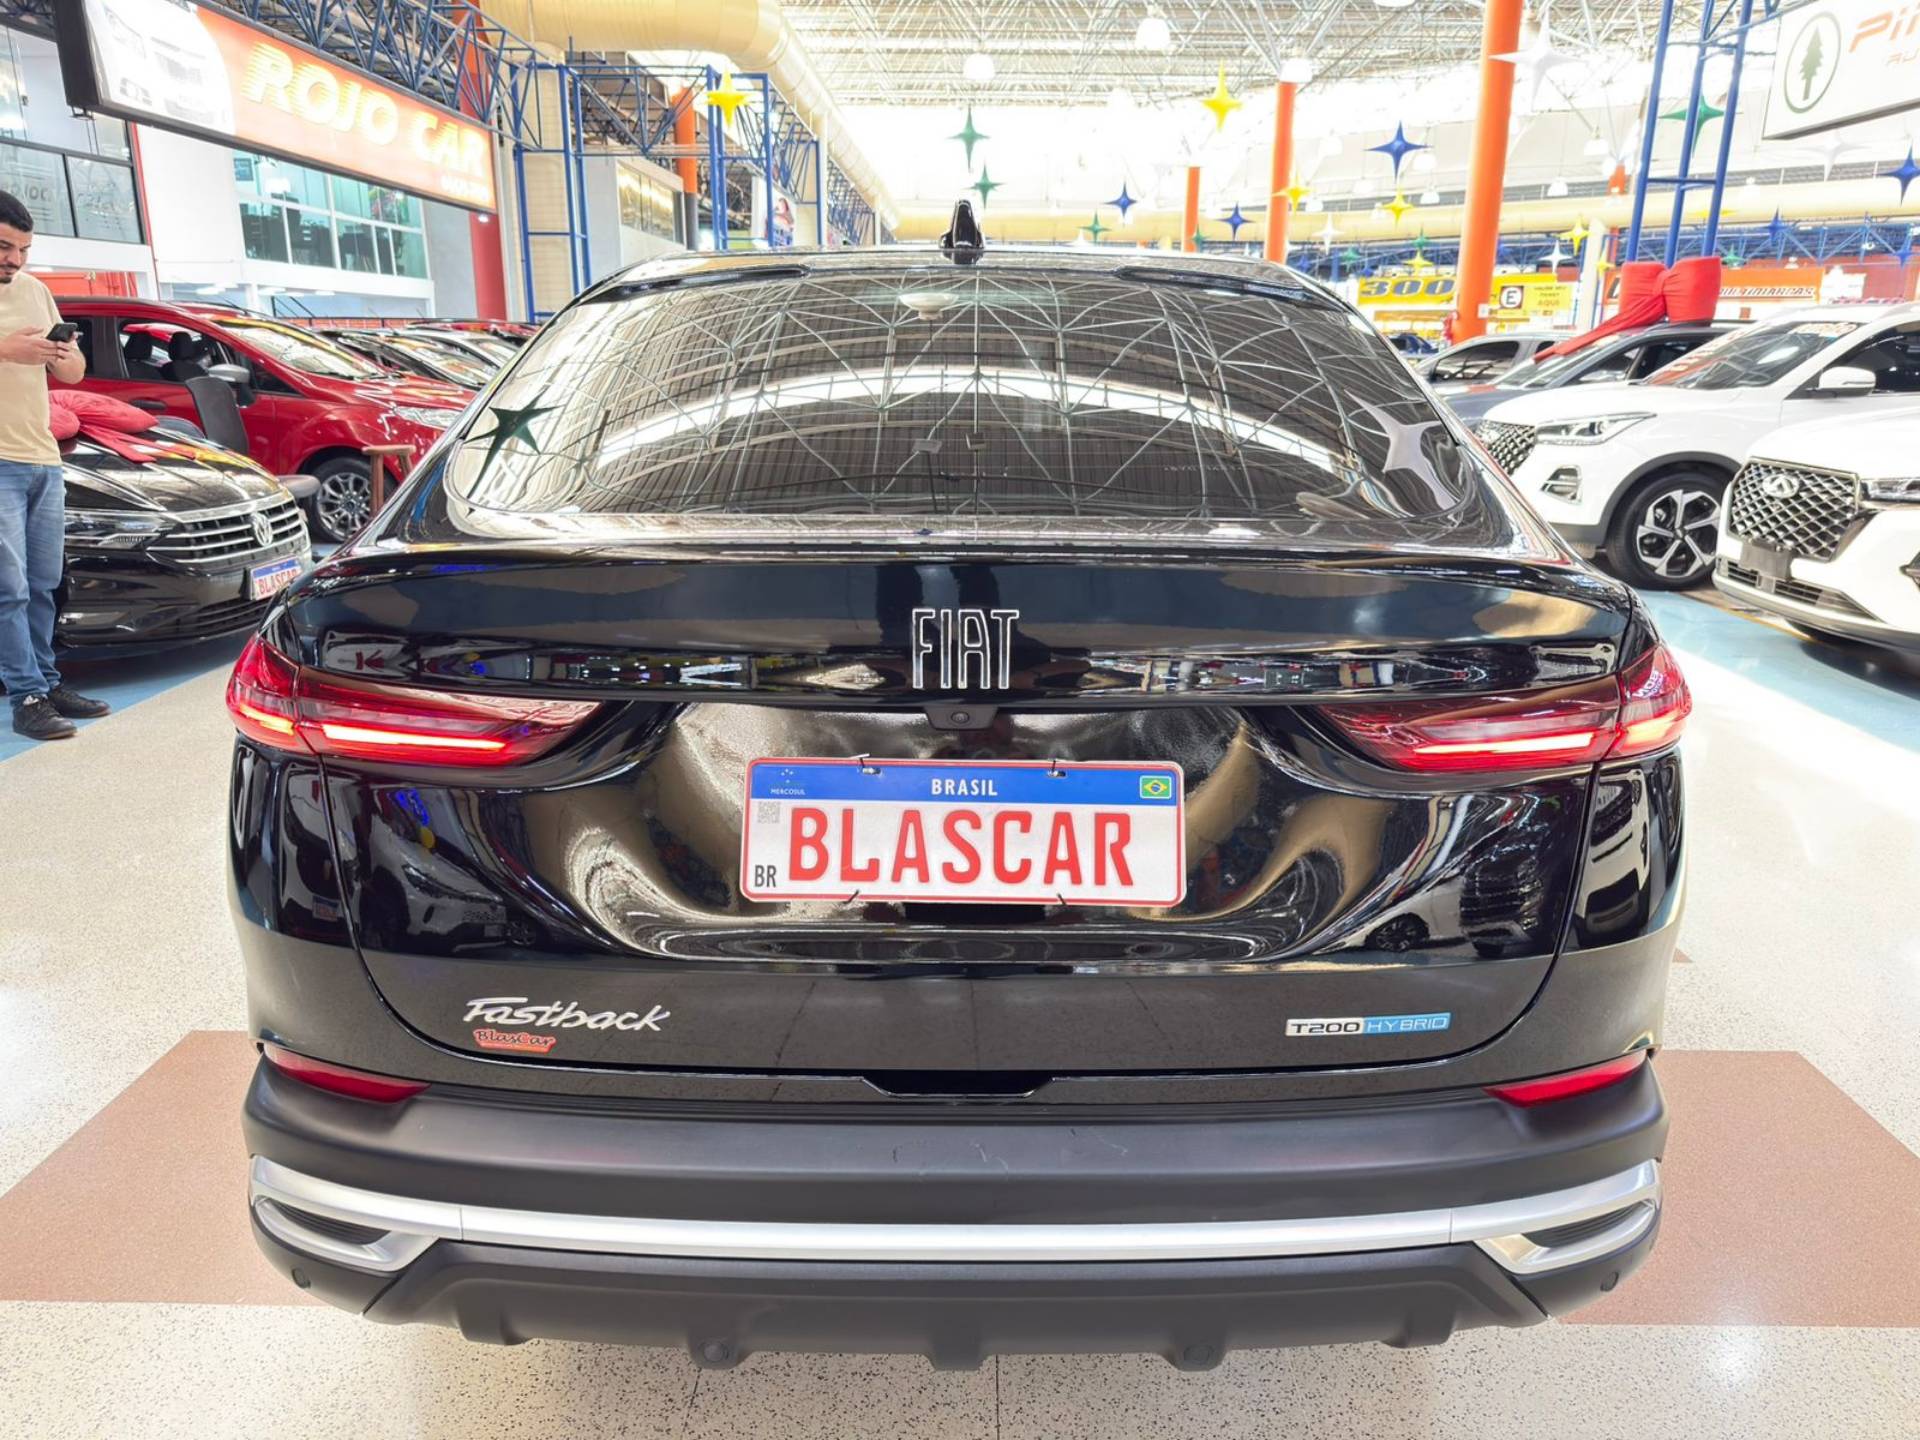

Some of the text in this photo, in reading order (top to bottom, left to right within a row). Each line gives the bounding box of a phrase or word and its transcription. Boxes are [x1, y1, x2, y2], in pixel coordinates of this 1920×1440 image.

[241, 43, 485, 178] ROJO CAR
[1360, 278, 1455, 297] 300
[1506, 290, 1517, 305] E
[912, 608, 1020, 690] FIAT
[770, 788, 806, 796] MERCOSUL
[931, 778, 998, 796] BRASIL
[789, 807, 1134, 887] BLASCAR
[754, 865, 777, 888] BR
[462, 996, 671, 1032] Fastback
[1290, 1016, 1449, 1034] T200 HYBRID
[475, 1028, 556, 1047] BlasCar
